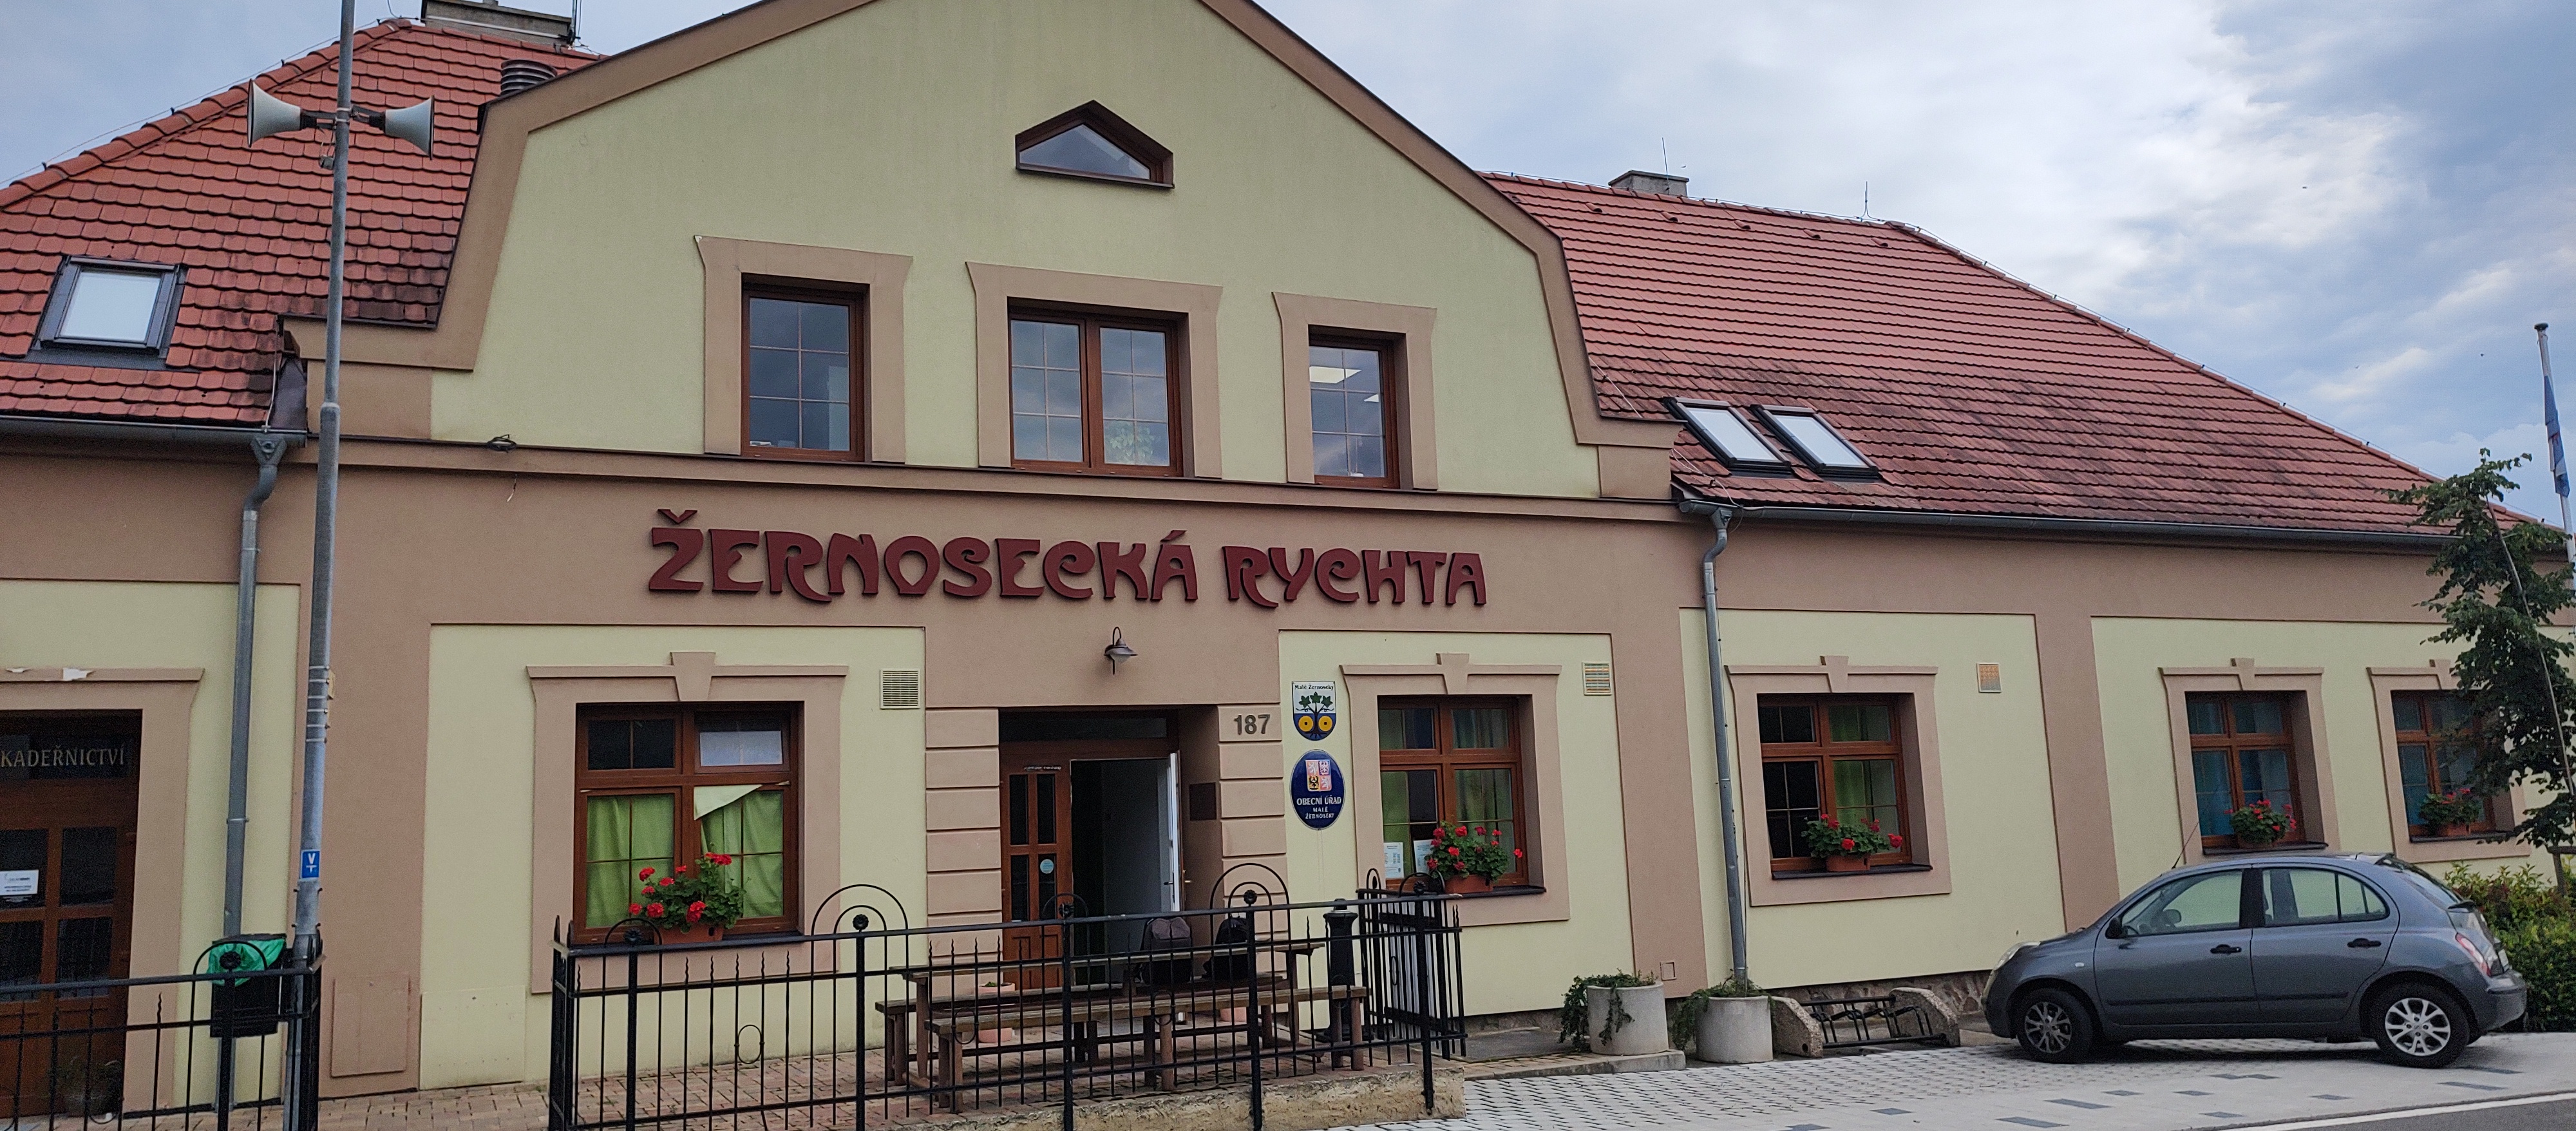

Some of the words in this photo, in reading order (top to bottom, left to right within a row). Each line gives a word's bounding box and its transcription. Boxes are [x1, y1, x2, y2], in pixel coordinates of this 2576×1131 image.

[649, 508, 1198, 602] ŽERNOSECKÁ
[1222, 545, 1487, 608] RYCHTA
[1233, 714, 1271, 735] 187
[1, 742, 125, 767] KADEŘNICTVÍ
[1296, 795, 1323, 806] OBECNÍ
[1324, 795, 1342, 805] ÚŘAD
[308, 853, 316, 864] V
